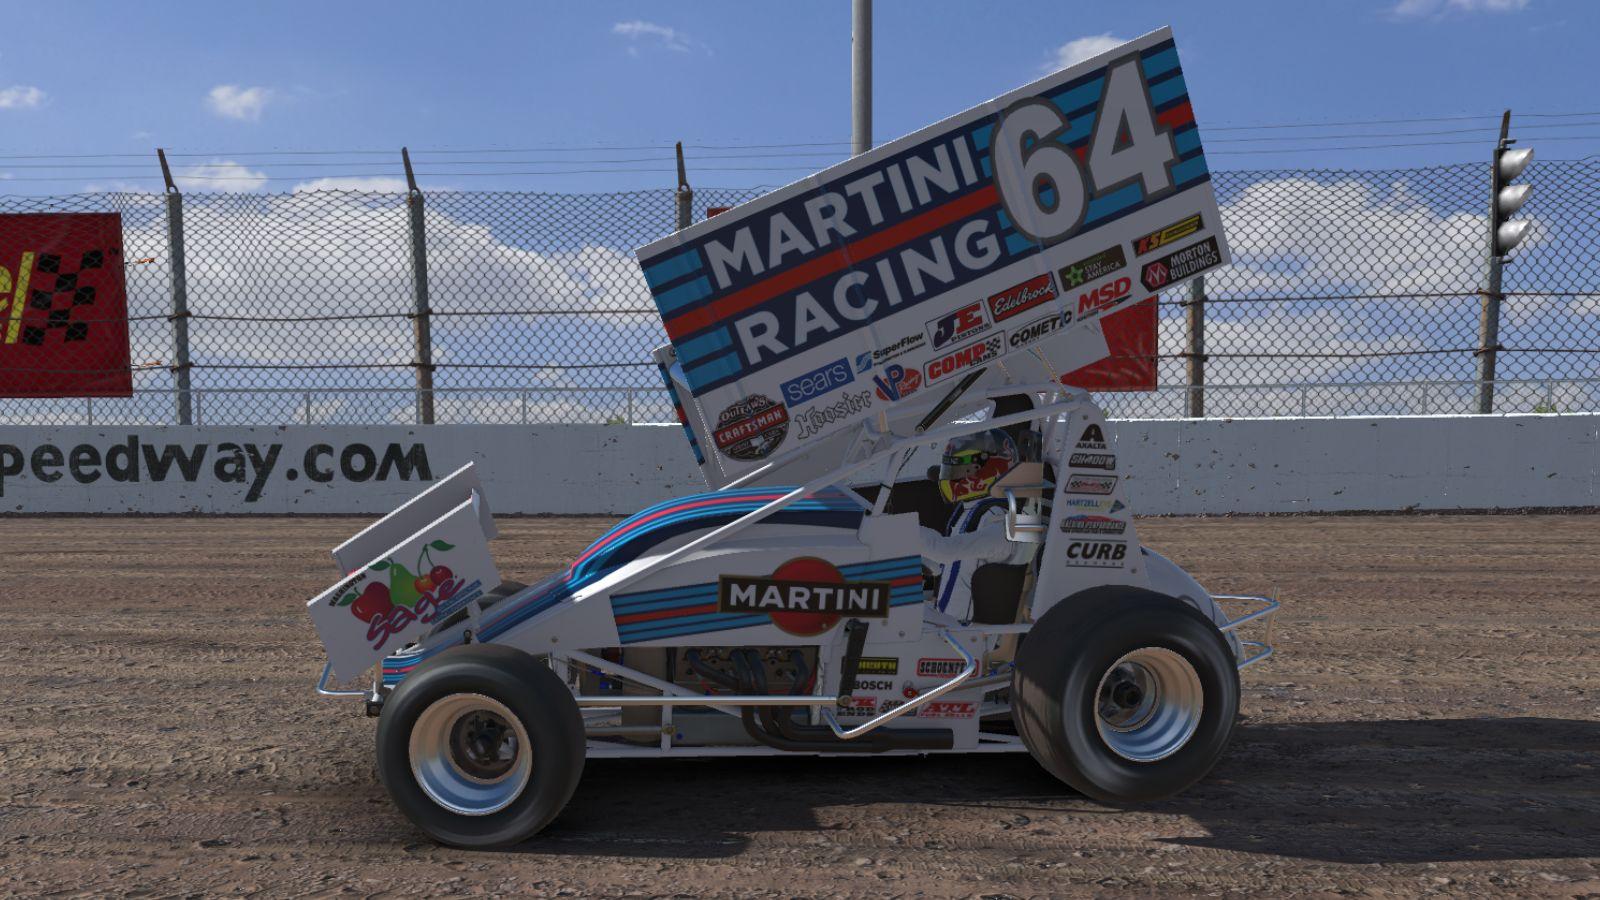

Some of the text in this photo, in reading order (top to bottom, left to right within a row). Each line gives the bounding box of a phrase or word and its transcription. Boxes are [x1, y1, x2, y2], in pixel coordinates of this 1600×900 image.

[991, 53, 1178, 243] 64
[704, 135, 978, 290] MARTINI
[1087, 261, 1120, 280] AMERICA
[1170, 250, 1218, 280] BUILDINGS
[1171, 240, 1211, 268] MORTON
[734, 219, 1001, 366] RACING
[994, 284, 1055, 315] Edelbrock
[1077, 276, 1132, 315] MSD
[934, 303, 982, 348] JE
[873, 332, 923, 359] SuperFlow
[928, 342, 986, 379] COMP
[788, 364, 848, 401] sears
[873, 364, 904, 401] VP
[719, 409, 783, 442] CRAFTSMAN
[795, 390, 872, 439] Hoosier
[1075, 442, 1107, 450] AXALTA
[1067, 542, 1127, 560] CURB
[730, 583, 880, 610] MARTINI
[920, 661, 976, 674] SCHOENFE
